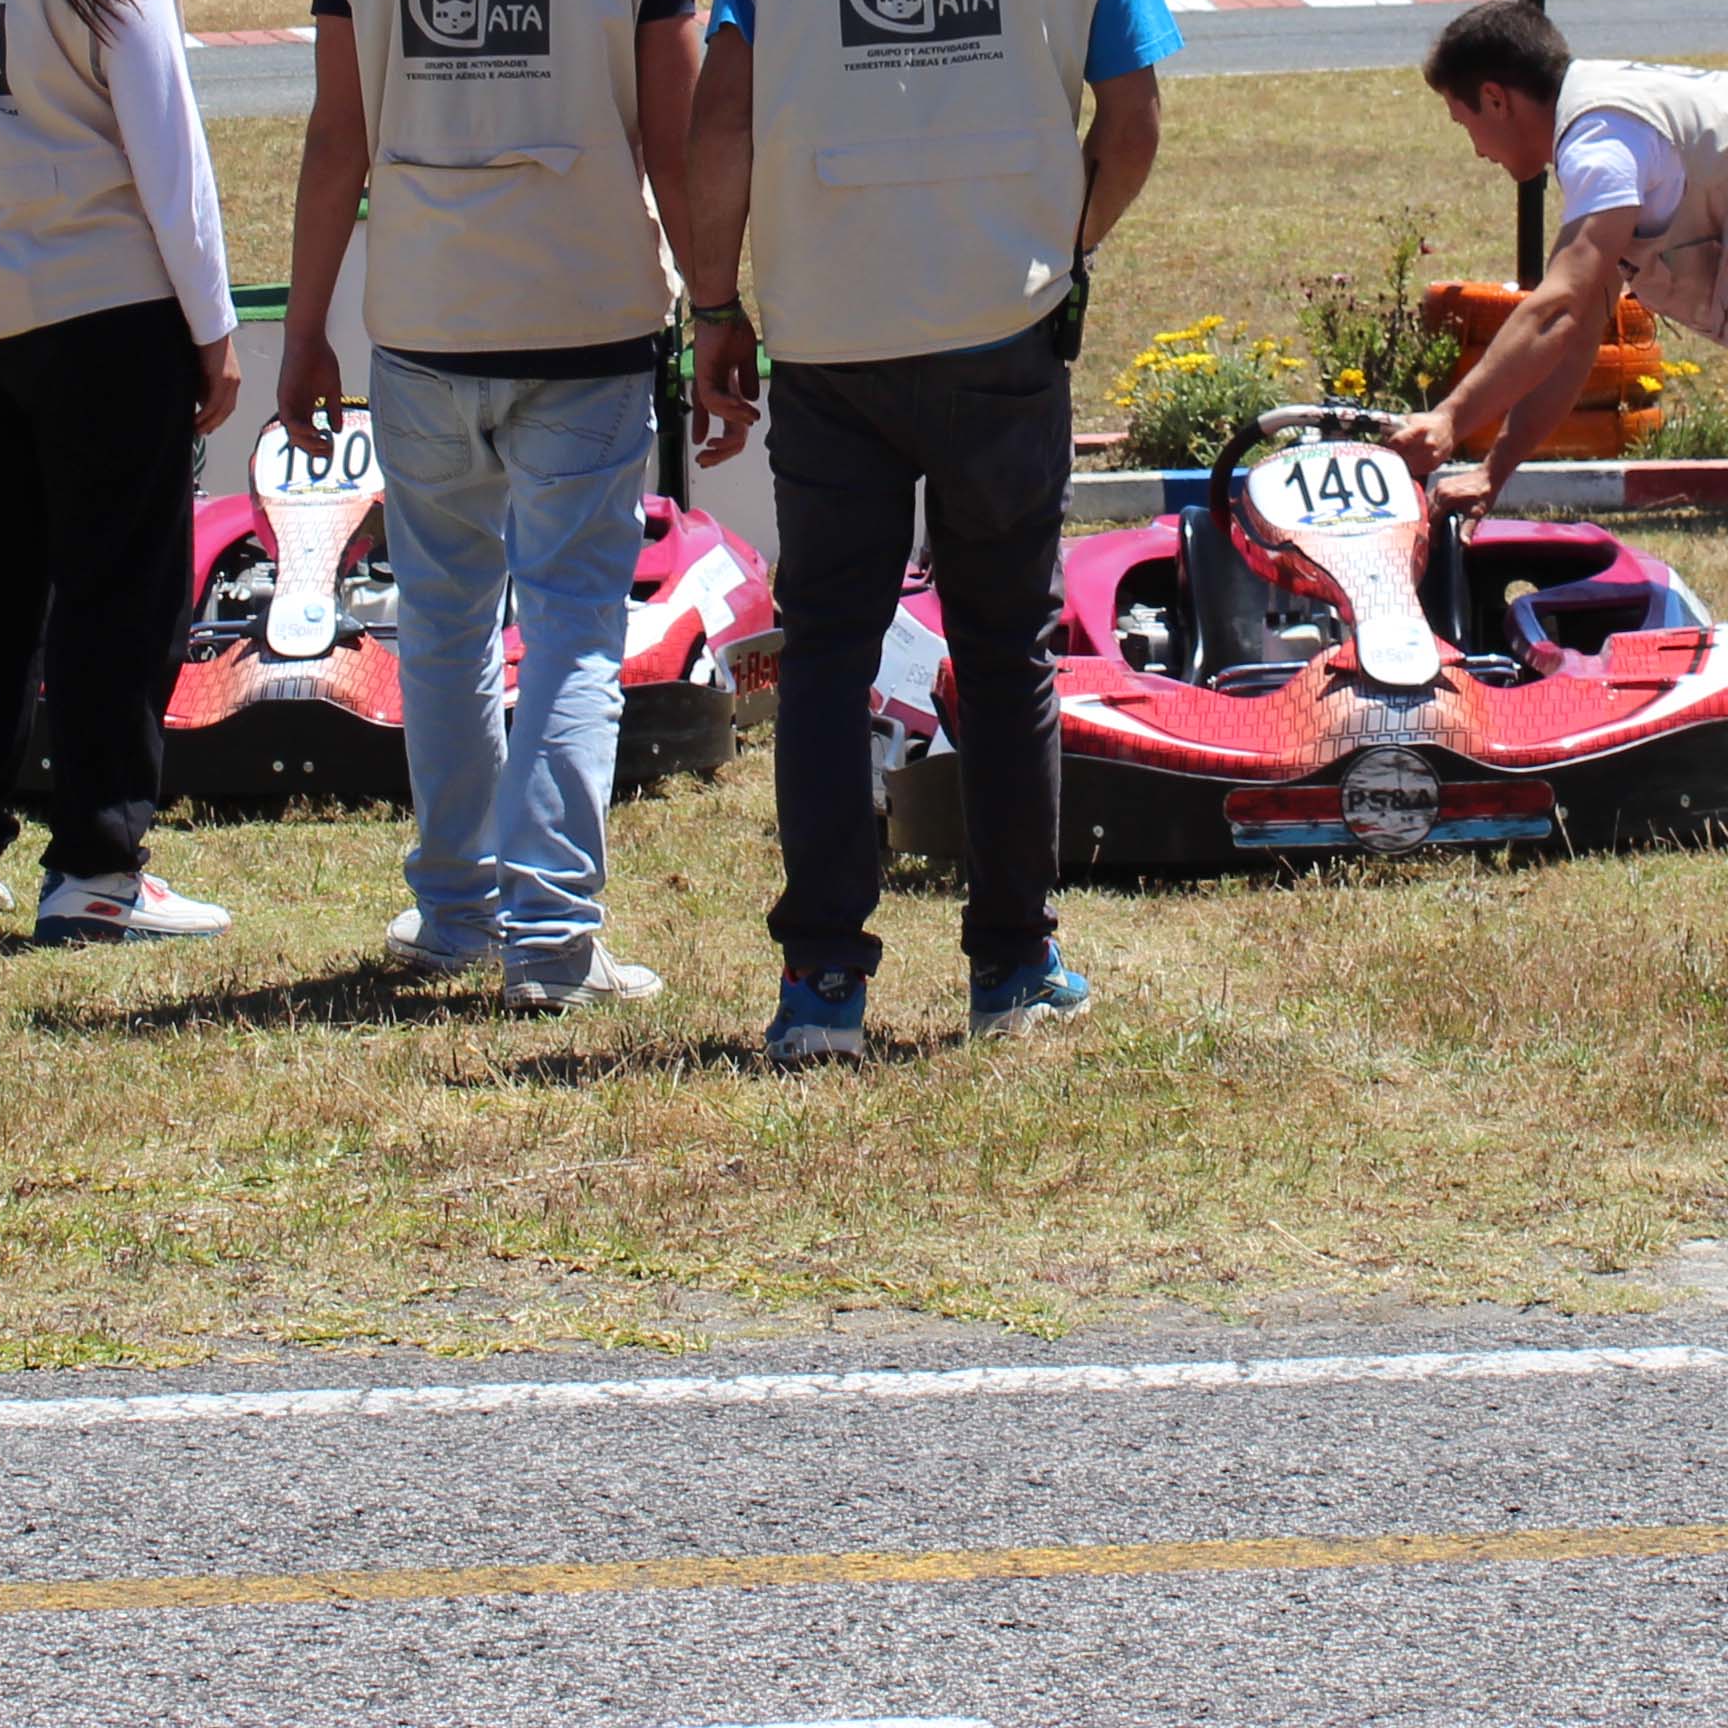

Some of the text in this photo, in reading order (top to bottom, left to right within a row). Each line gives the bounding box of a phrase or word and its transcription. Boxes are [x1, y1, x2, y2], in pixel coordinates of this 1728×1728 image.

[866, 48, 902, 58] GRUPO
[917, 41, 981, 55] ACTIVIDADES
[844, 59, 902, 71] TERRESTRES
[942, 57, 949, 65] E
[1284, 457, 1390, 513] 140
